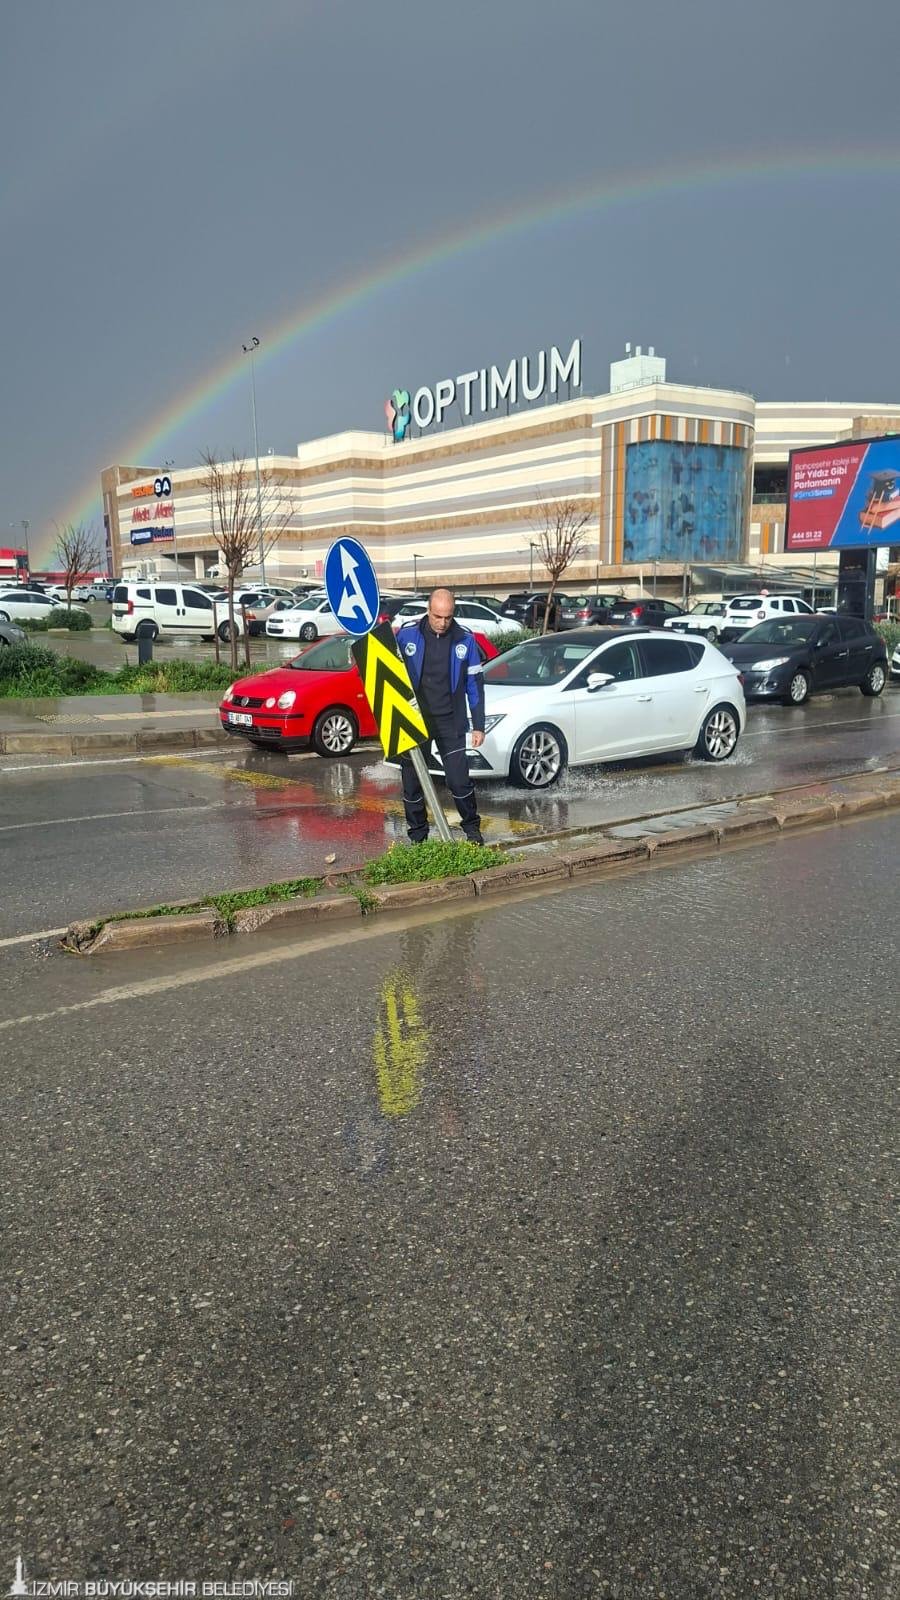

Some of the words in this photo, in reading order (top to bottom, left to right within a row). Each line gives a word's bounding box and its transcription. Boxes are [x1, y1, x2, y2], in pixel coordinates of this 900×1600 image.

[413, 338, 581, 428] OPTIMUM
[794, 471, 806, 480] Bir
[807, 469, 829, 478] Yıldız
[830, 465, 847, 476] Gibi
[794, 478, 841, 489] Parlamanın
